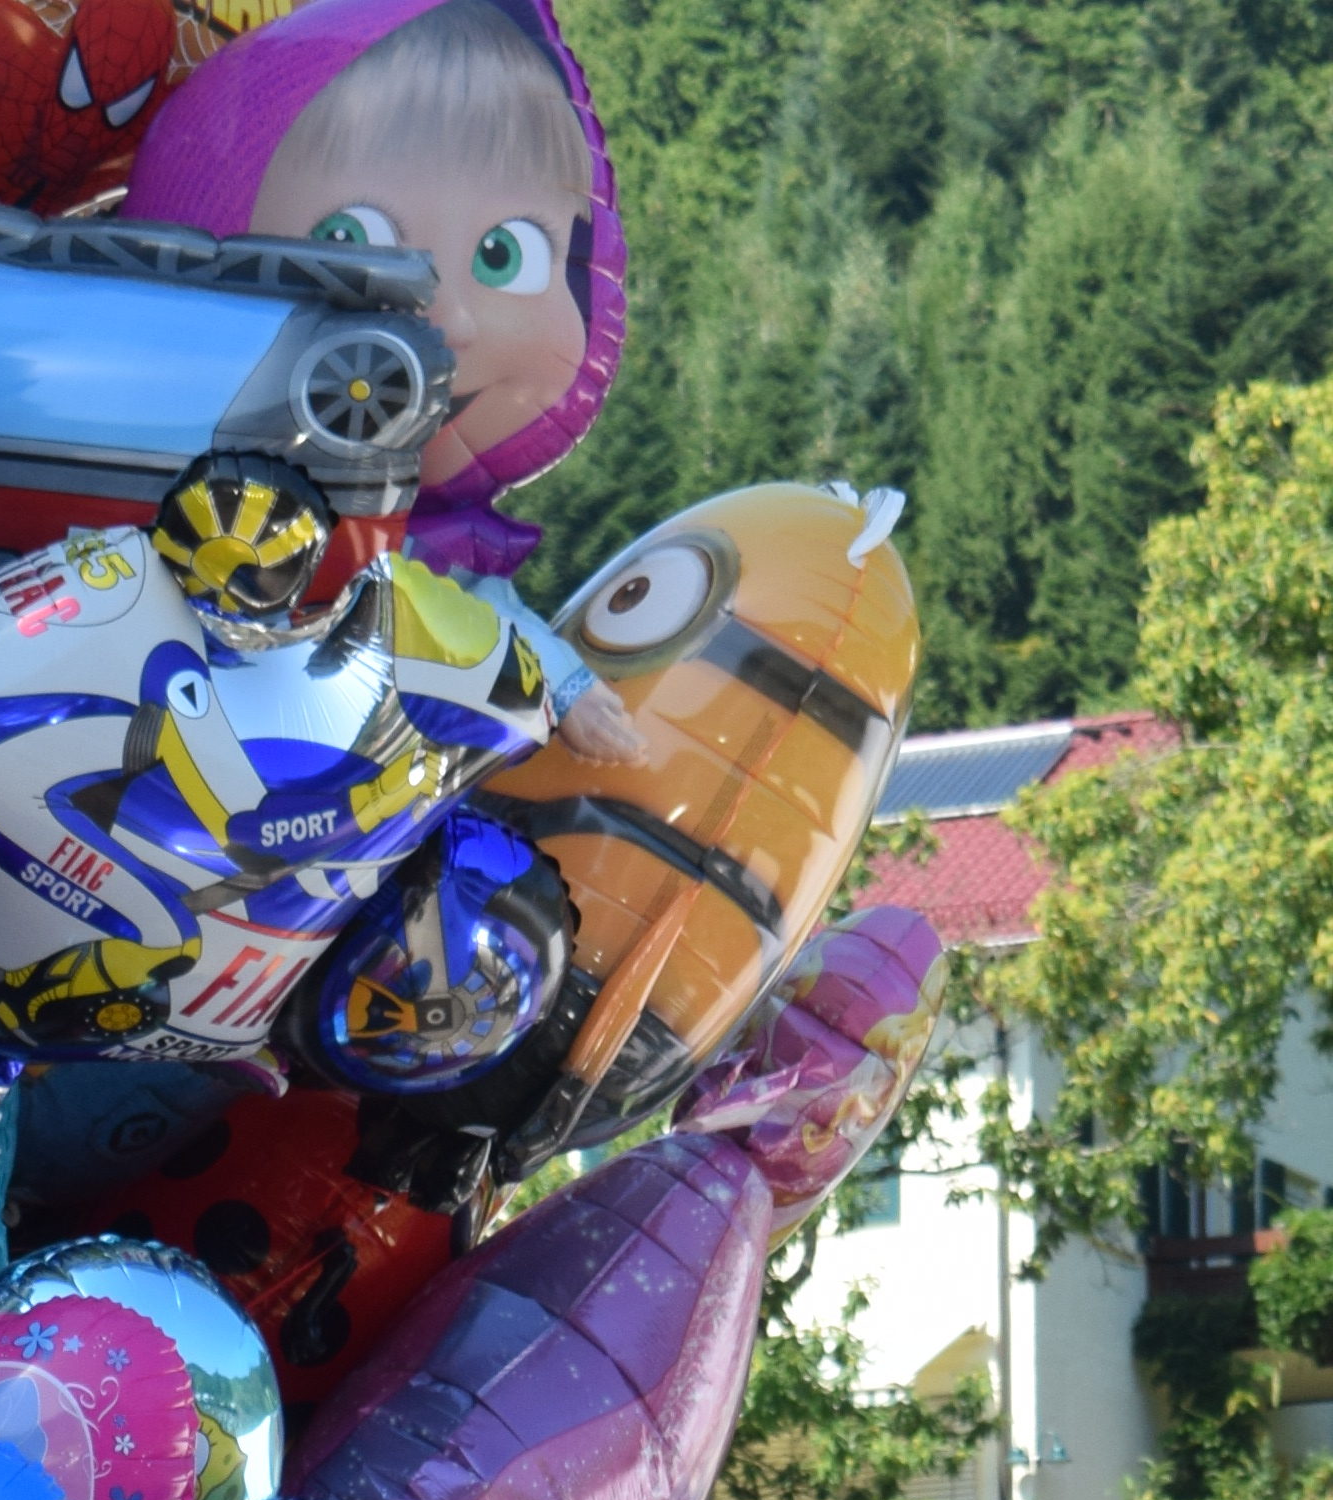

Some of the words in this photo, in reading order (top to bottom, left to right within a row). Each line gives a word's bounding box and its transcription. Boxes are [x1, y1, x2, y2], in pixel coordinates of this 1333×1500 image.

[260, 810, 337, 848] SPORT
[20, 862, 103, 920] SPORT
[47, 837, 114, 893] FIAC
[179, 945, 311, 1028] FIA
[144, 1035, 241, 1061] SPORT
